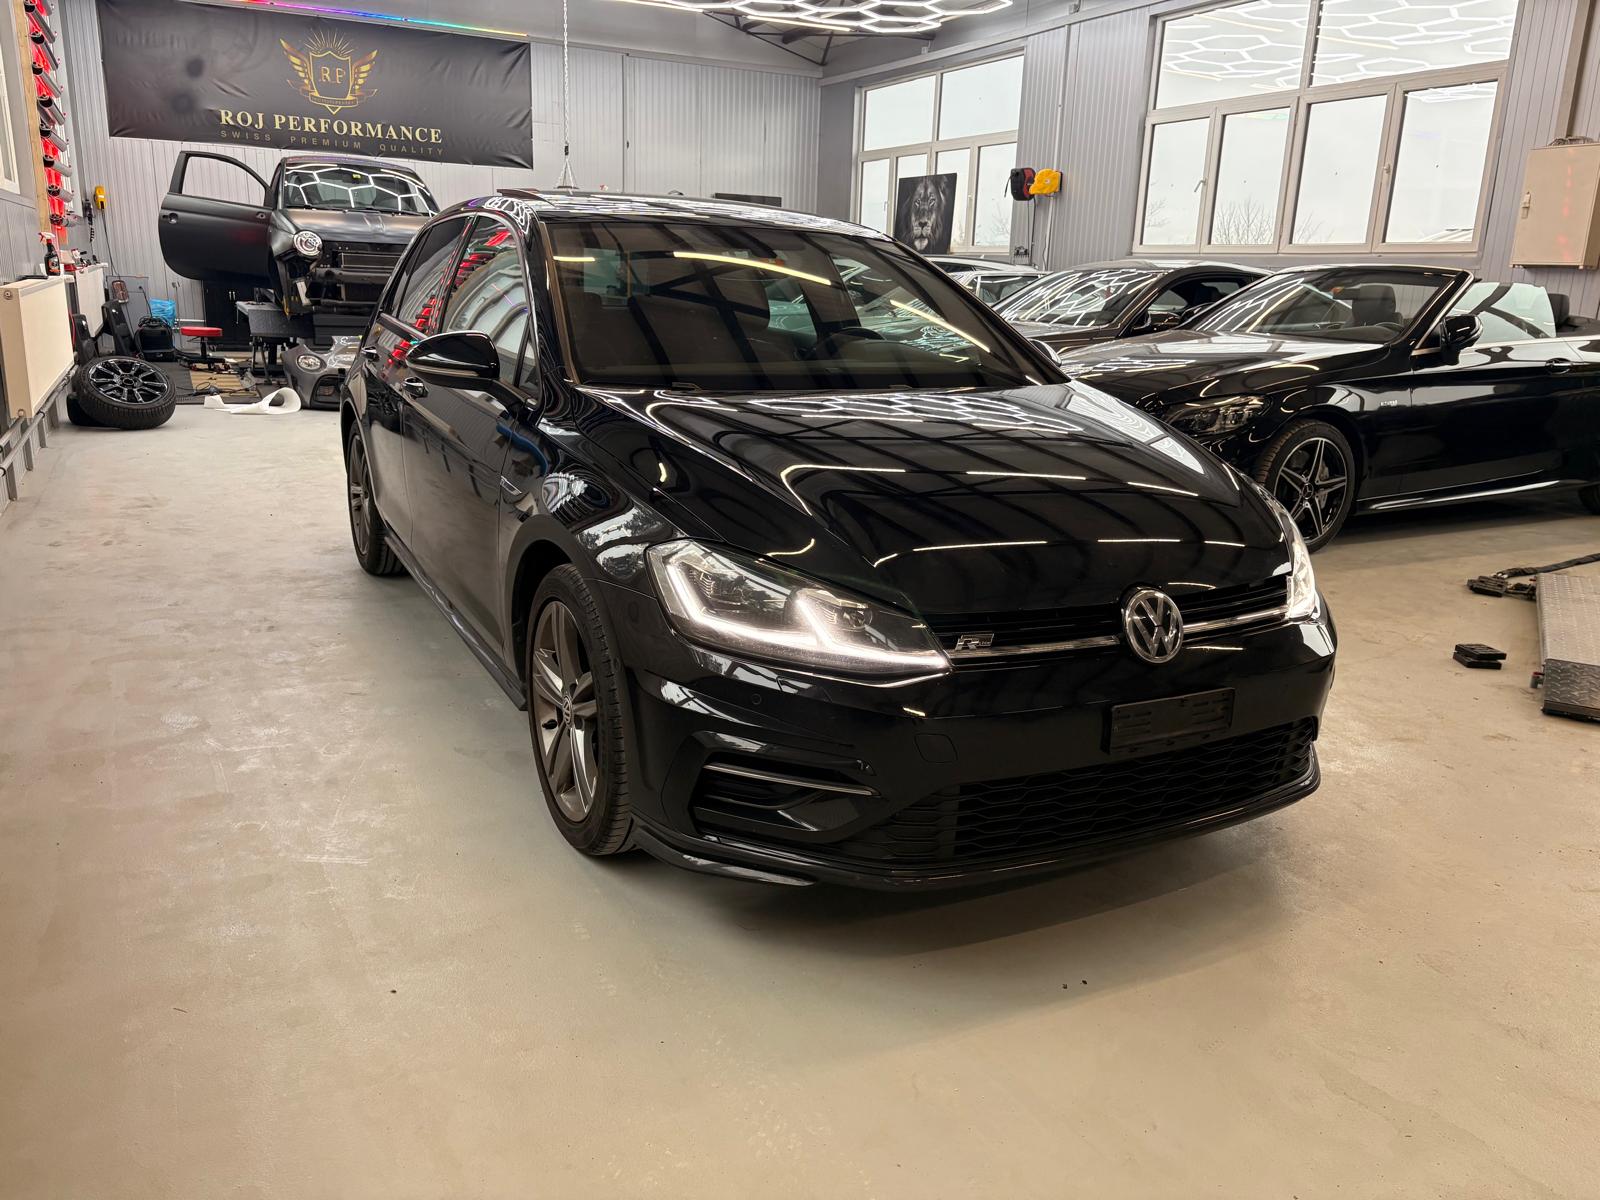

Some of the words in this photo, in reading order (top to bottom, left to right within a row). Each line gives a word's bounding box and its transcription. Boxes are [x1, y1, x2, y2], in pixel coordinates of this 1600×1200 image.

[219, 109, 264, 130] ROJ
[273, 113, 443, 144] PERFORMANCE
[220, 130, 272, 142] SWISS
[290, 136, 361, 149] PREMIUM
[379, 143, 443, 156] QUALITY
